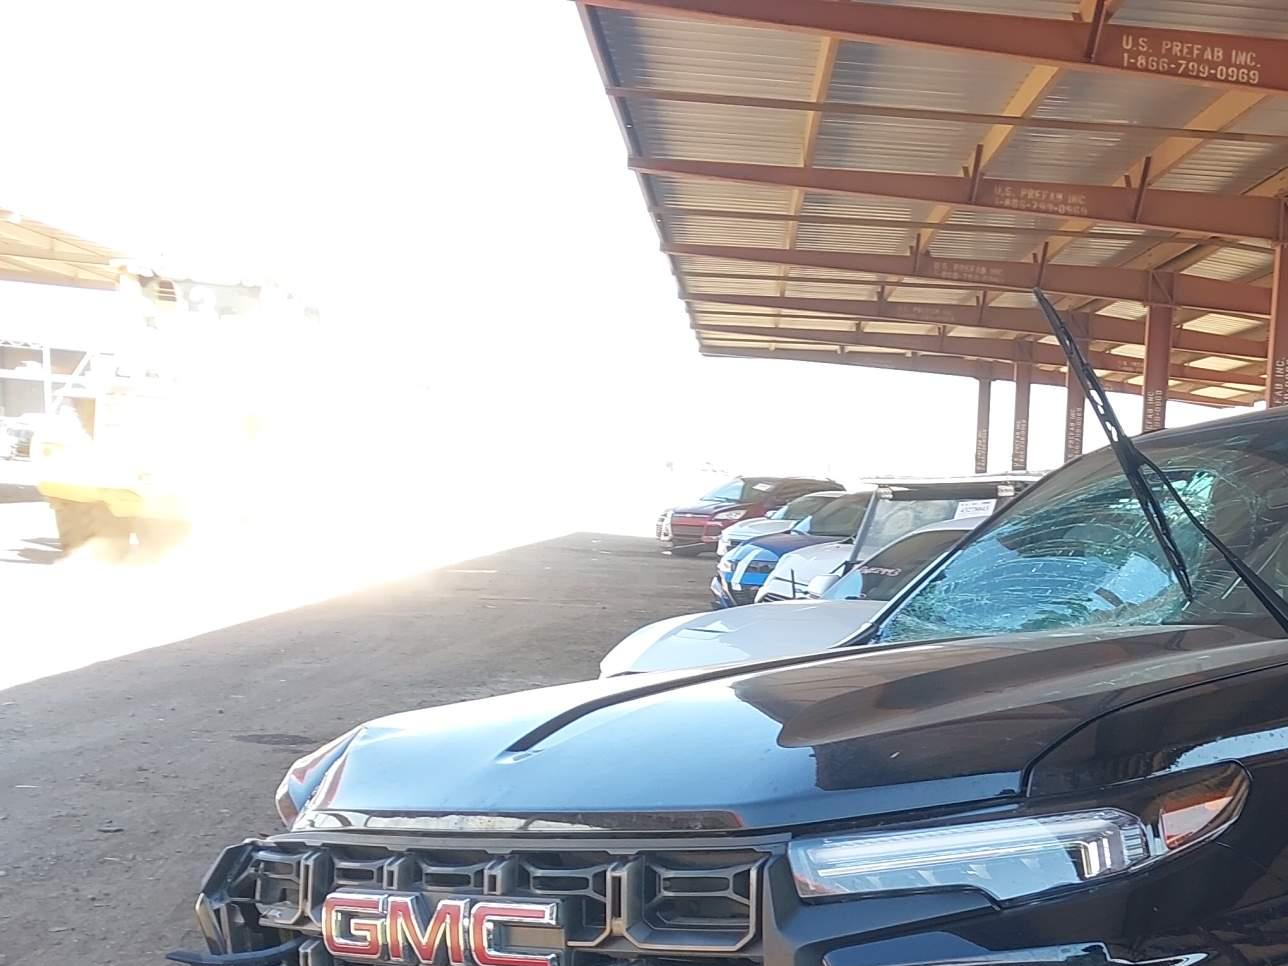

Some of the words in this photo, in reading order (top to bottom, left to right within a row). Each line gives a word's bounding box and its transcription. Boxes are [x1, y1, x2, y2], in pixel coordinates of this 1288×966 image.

[1122, 34, 1153, 53] U.S.
[1161, 40, 1223, 62] PREFAB
[1231, 49, 1261, 68] INC.
[1122, 52, 1260, 84] 1-866-799-0969
